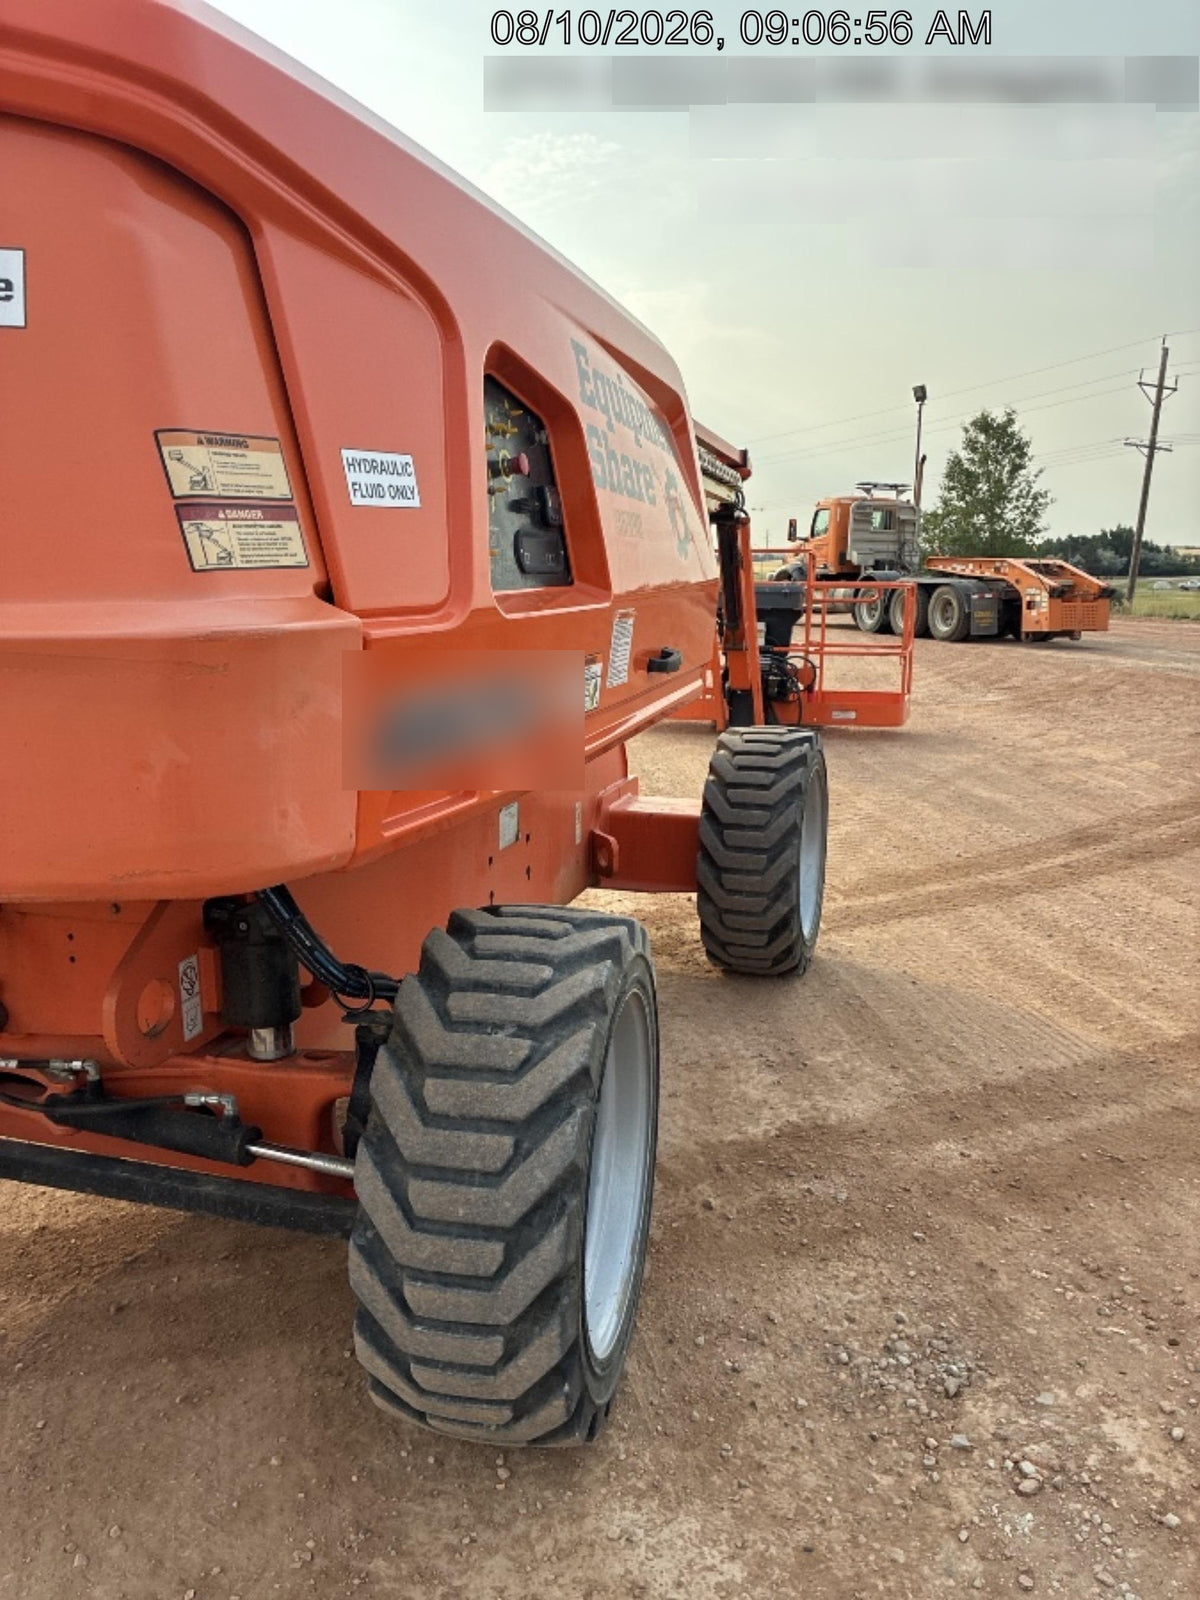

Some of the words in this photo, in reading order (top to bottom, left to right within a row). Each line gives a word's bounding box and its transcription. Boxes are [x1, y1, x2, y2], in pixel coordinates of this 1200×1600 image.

[204, 436, 250, 449] WARNING
[346, 456, 414, 477] HYDRAULIC
[586, 423, 657, 508] Share
[351, 481, 387, 499] FLUID
[387, 484, 416, 500] ONLY
[224, 508, 265, 520] DANGER
